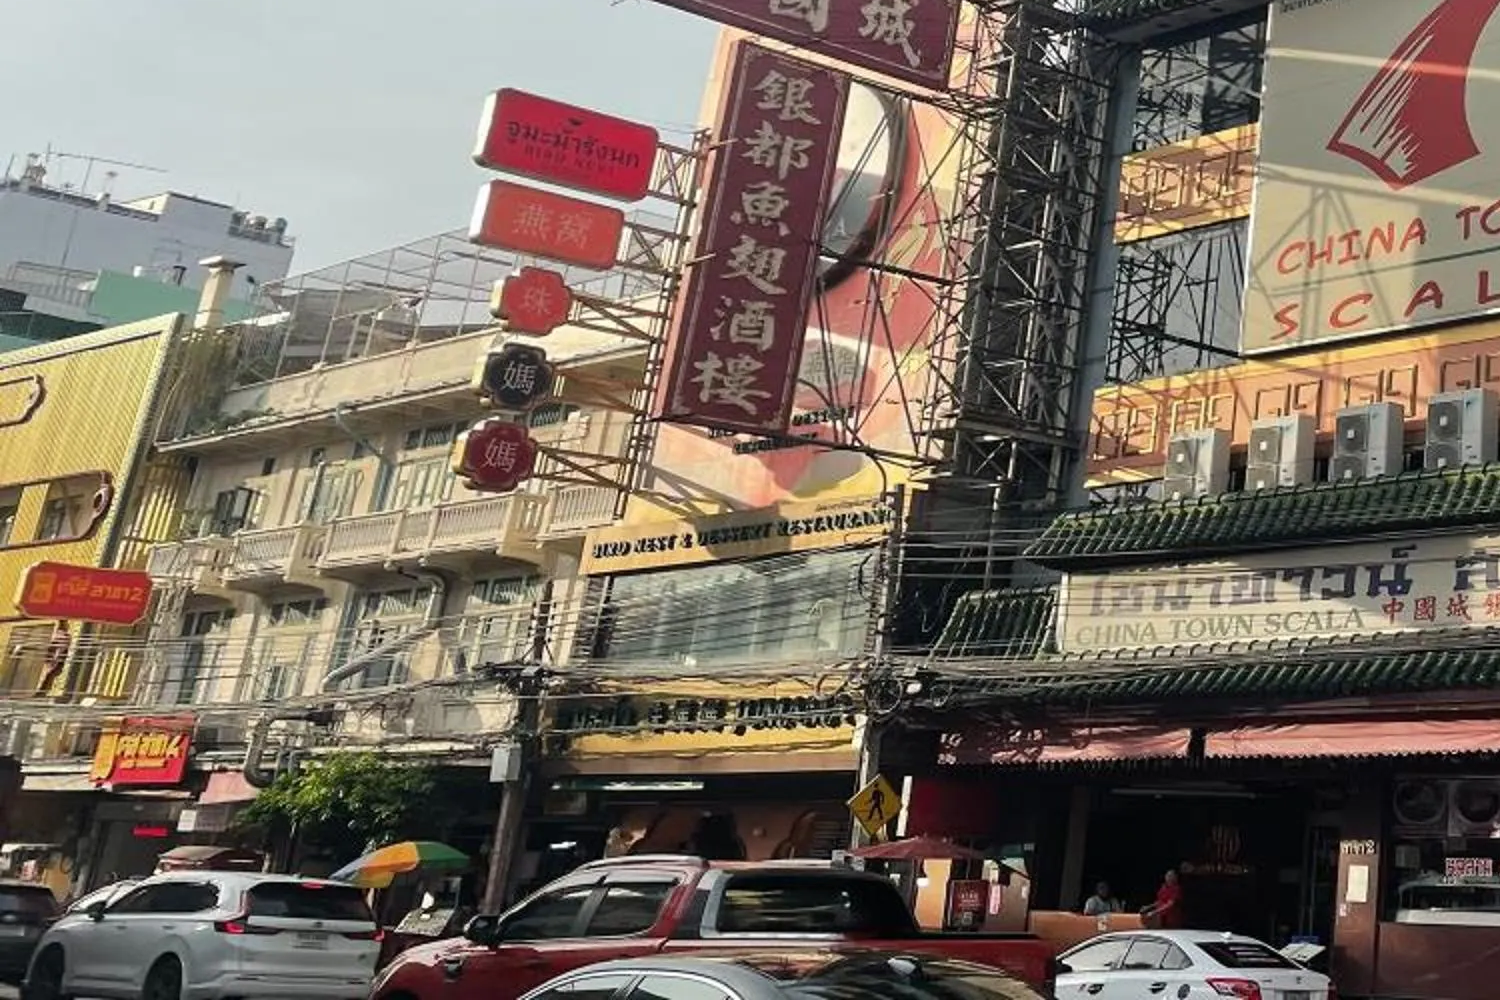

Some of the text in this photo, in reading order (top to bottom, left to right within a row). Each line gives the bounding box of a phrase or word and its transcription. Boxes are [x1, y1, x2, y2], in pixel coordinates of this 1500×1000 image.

[691, 69, 822, 415] 銀都魚翅酒樓
[1277, 217, 1428, 277] CHINA
[501, 360, 539, 395] 媽
[482, 438, 520, 472] 媽
[1075, 608, 1364, 646] CHINA TOWN SCALA
